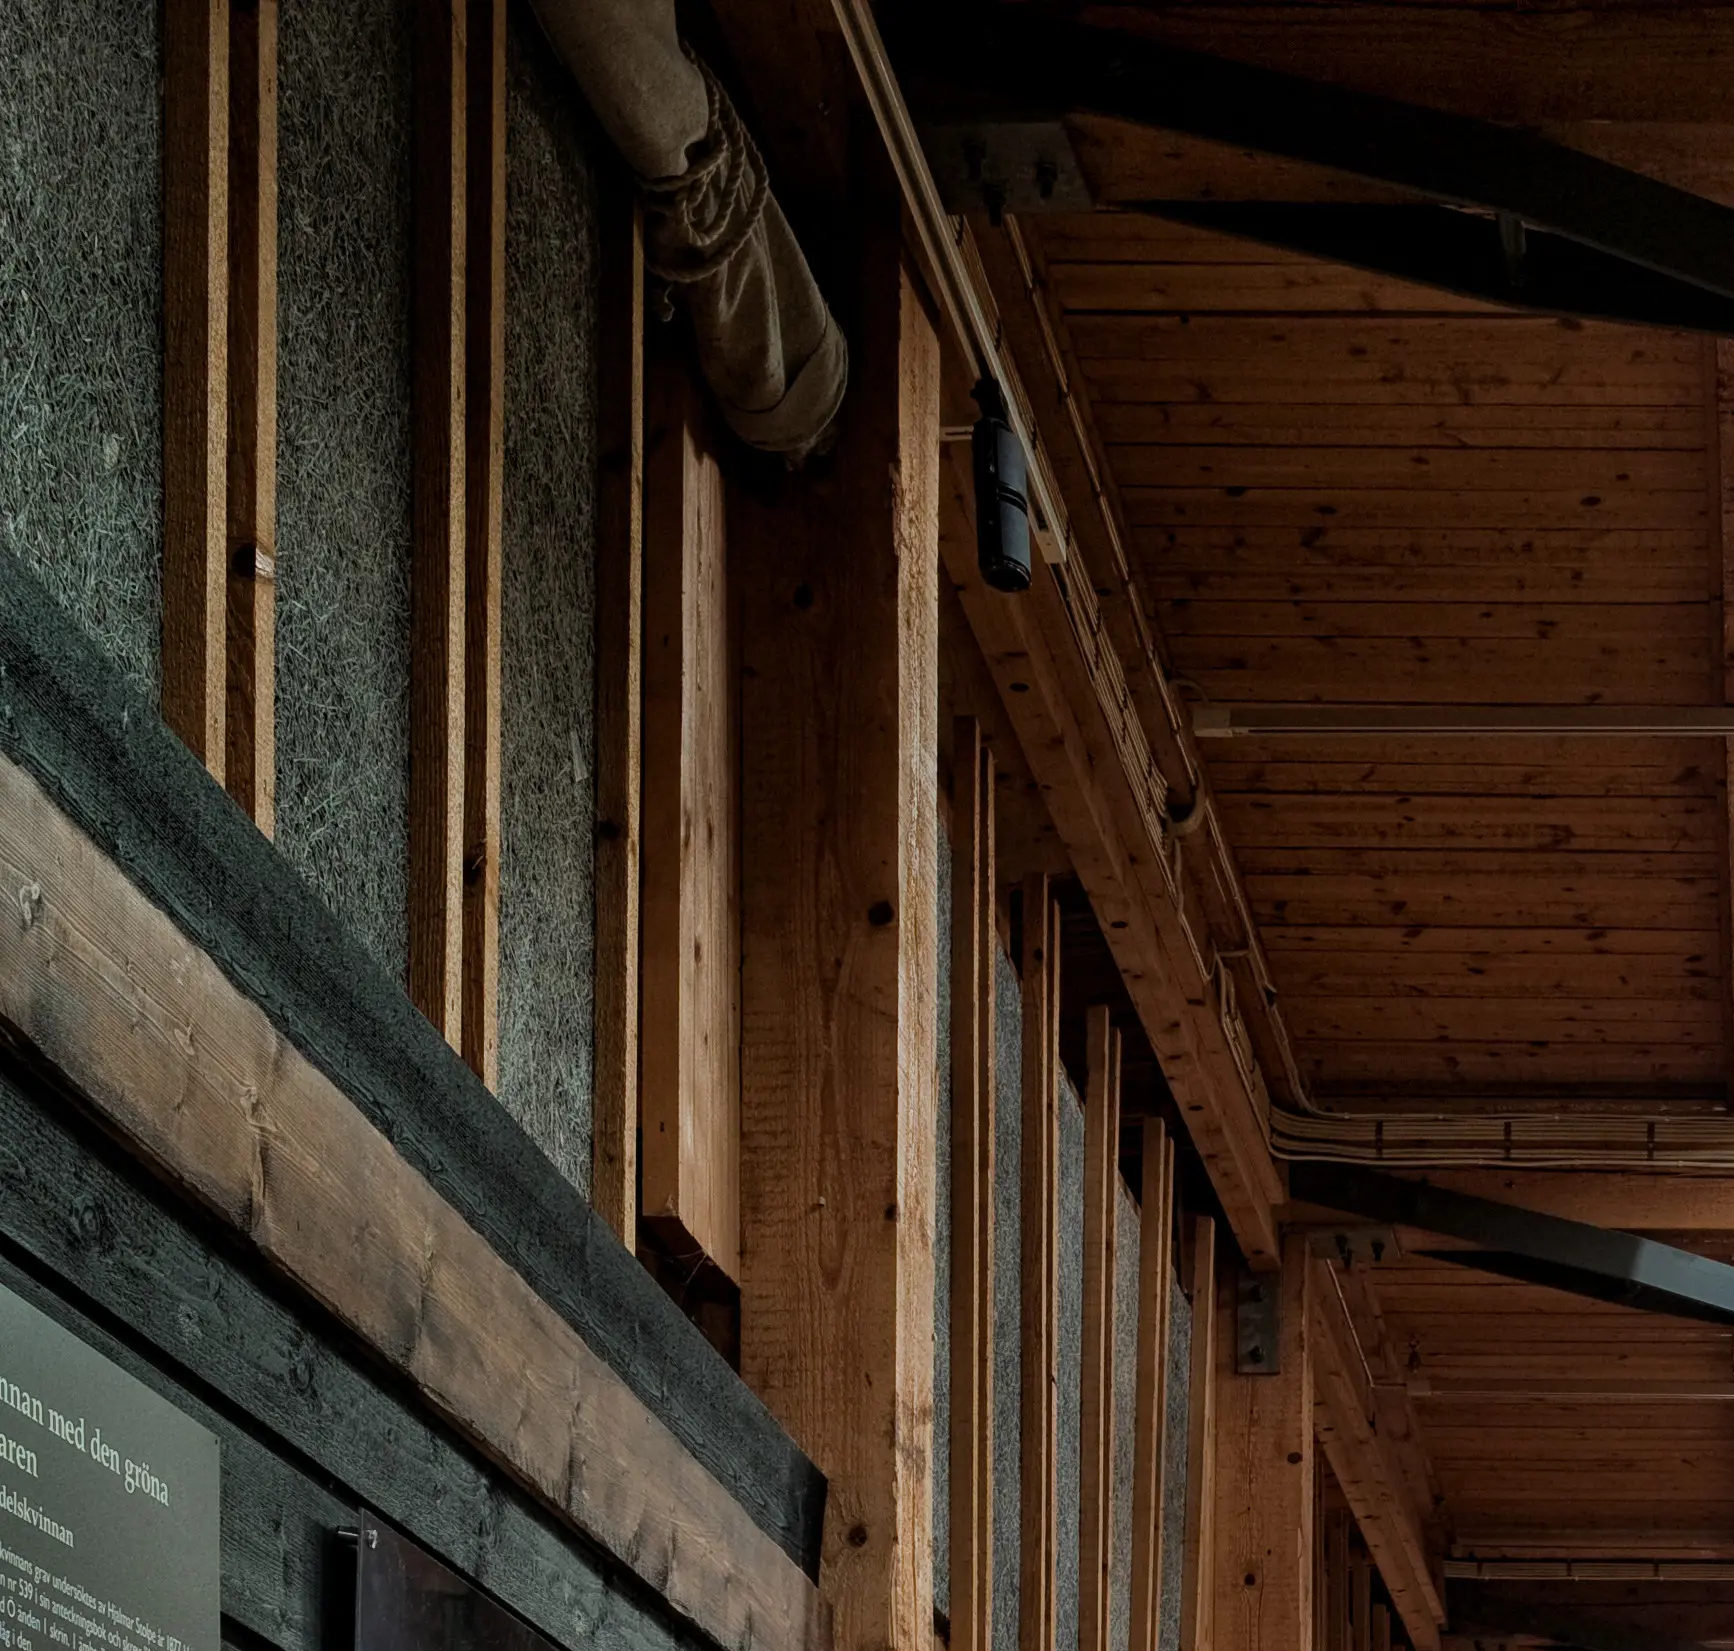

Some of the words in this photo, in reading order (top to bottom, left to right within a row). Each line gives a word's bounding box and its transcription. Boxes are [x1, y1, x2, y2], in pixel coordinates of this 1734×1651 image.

[0, 1433, 38, 1477] aren
[47, 1409, 86, 1452] med
[90, 1428, 121, 1474] den
[124, 1459, 169, 1506] gröna
[0, 1485, 74, 1547] delskvinnan
[7, 1577, 17, 1598] nr
[18, 1577, 33, 1600] 539
[39, 1591, 50, 1610] sin
[51, 1601, 107, 1640] anteckningsbok
[107, 1630, 121, 1648] och
[17, 1604, 40, 1631] änden
[49, 1622, 70, 1647] skrin.
[33, 1566, 51, 1584] grav
[52, 1576, 97, 1609] undersöktes
[97, 1600, 106, 1615] av
[107, 1601, 134, 1630] Hjalmar
[135, 1616, 156, 1645] Stolpe
